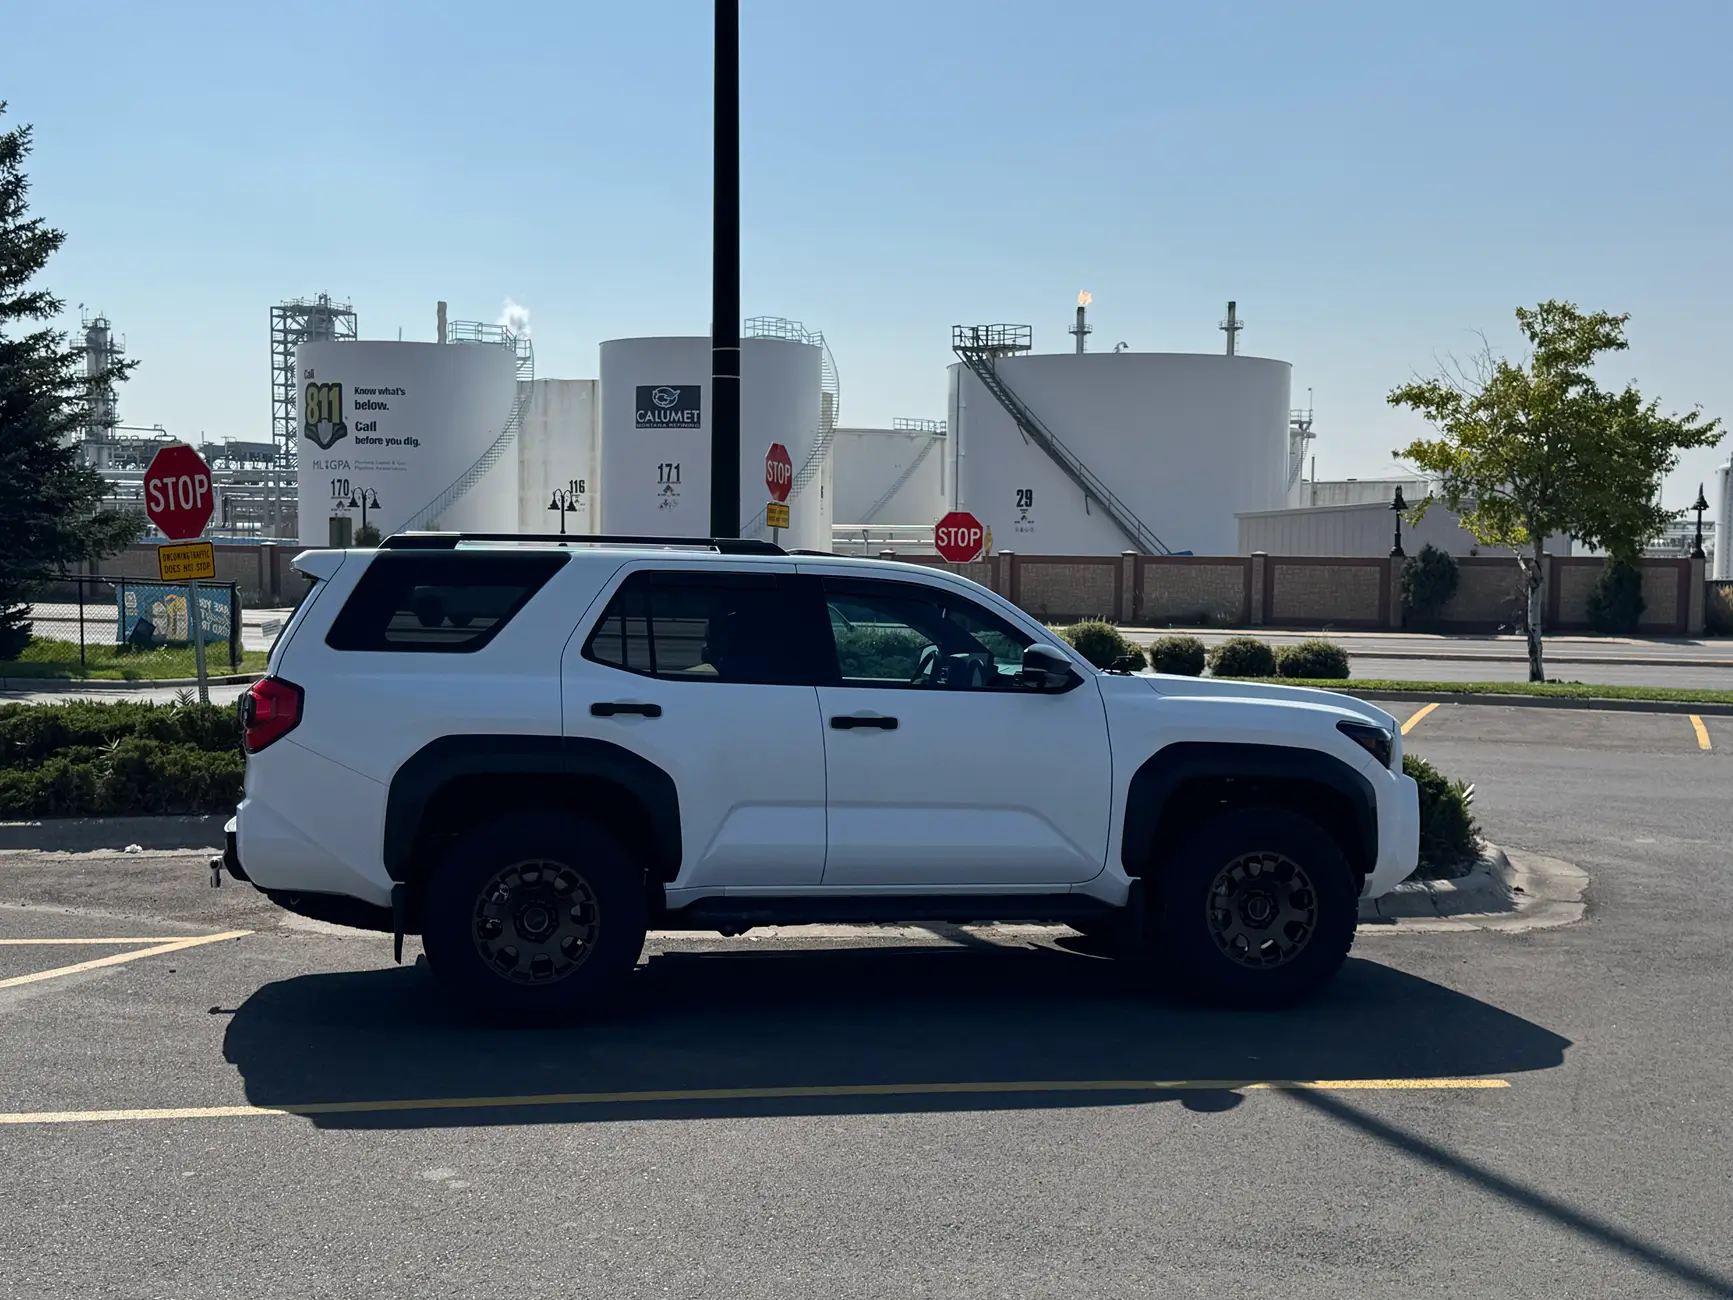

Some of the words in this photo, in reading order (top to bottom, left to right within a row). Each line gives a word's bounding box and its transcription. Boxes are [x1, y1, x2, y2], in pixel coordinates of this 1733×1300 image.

[304, 369, 315, 380] Call
[354, 387, 376, 396] Know
[378, 387, 406, 396] what's
[306, 385, 341, 425] 811
[354, 399, 390, 411] below.
[636, 410, 700, 422] CALUMET
[355, 421, 377, 432] Call
[355, 436, 384, 445] before
[385, 437, 402, 447] you
[404, 437, 421, 448] dig.
[657, 463, 680, 482] 171
[767, 460, 791, 485] STOP
[149, 474, 209, 513] STOP
[331, 478, 350, 496] 170
[569, 479, 585, 494] 116
[1016, 488, 1033, 508] 29
[937, 527, 981, 547] STOP
[162, 551, 190, 562] ONCOMING
[190, 549, 210, 560] TRAFFIC
[164, 564, 181, 574] DOES
[183, 563, 194, 573] NOT
[196, 562, 211, 572] STOP
